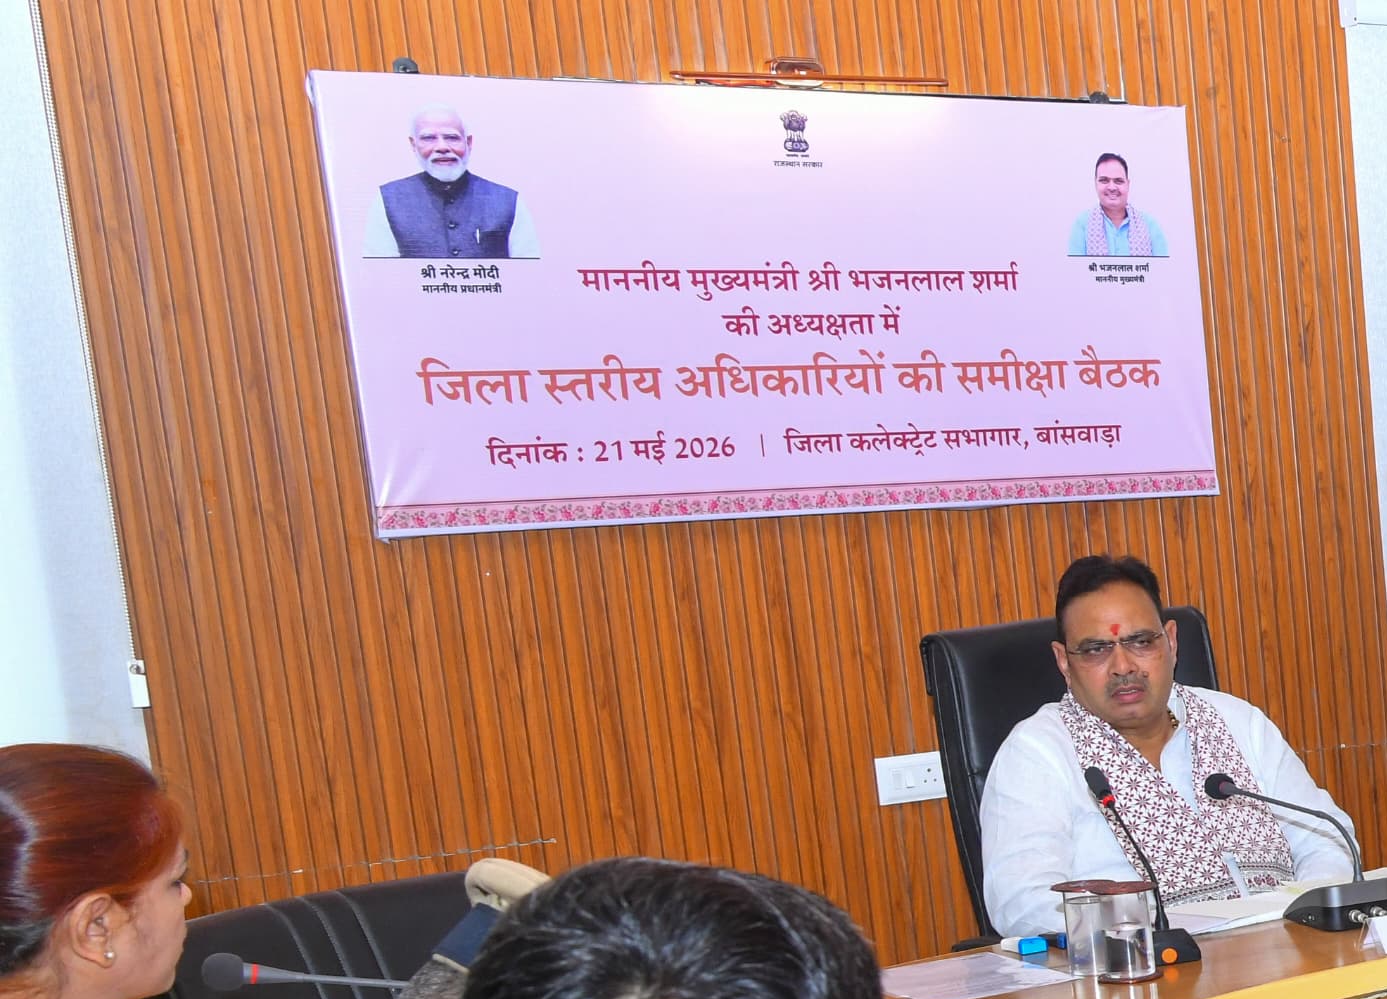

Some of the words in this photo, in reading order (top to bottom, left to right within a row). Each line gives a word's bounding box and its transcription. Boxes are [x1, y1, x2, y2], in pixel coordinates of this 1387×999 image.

[420, 264, 436, 279] श्री
[440, 264, 470, 280] नरेन्द्र
[472, 264, 500, 279] मोदी
[577, 260, 681, 292] माननीय
[686, 261, 799, 301] मुख्यमंत्री
[808, 261, 841, 291] श्री
[848, 269, 965, 292] भजनलाल
[969, 261, 1019, 294] शर्मा
[1088, 262, 1098, 272] श्री
[1099, 263, 1133, 273] भजनलाल
[1135, 262, 1150, 273] शर्मा
[1095, 274, 1119, 283] माननीय
[422, 282, 458, 293] माननीय
[460, 282, 502, 294] प्रधानमंत्री
[721, 305, 761, 337] की
[768, 312, 875, 341] अध्यक्षता
[879, 304, 901, 335] में
[415, 357, 531, 406] जिला
[537, 354, 662, 405] स्तरीय
[675, 349, 886, 399] अधिकारियों
[893, 350, 946, 394] की
[951, 349, 1068, 398] समीक्षा
[1074, 344, 1162, 390] बैठक
[486, 436, 568, 469] दिनांक
[594, 440, 624, 462] 21
[629, 430, 667, 465] मई
[675, 436, 736, 460] 2026
[783, 427, 843, 455] जिला
[846, 422, 937, 457] कलेक्ट्रेट
[941, 426, 1029, 451] सभागार,
[1033, 420, 1122, 449] बांसवाड़ा
